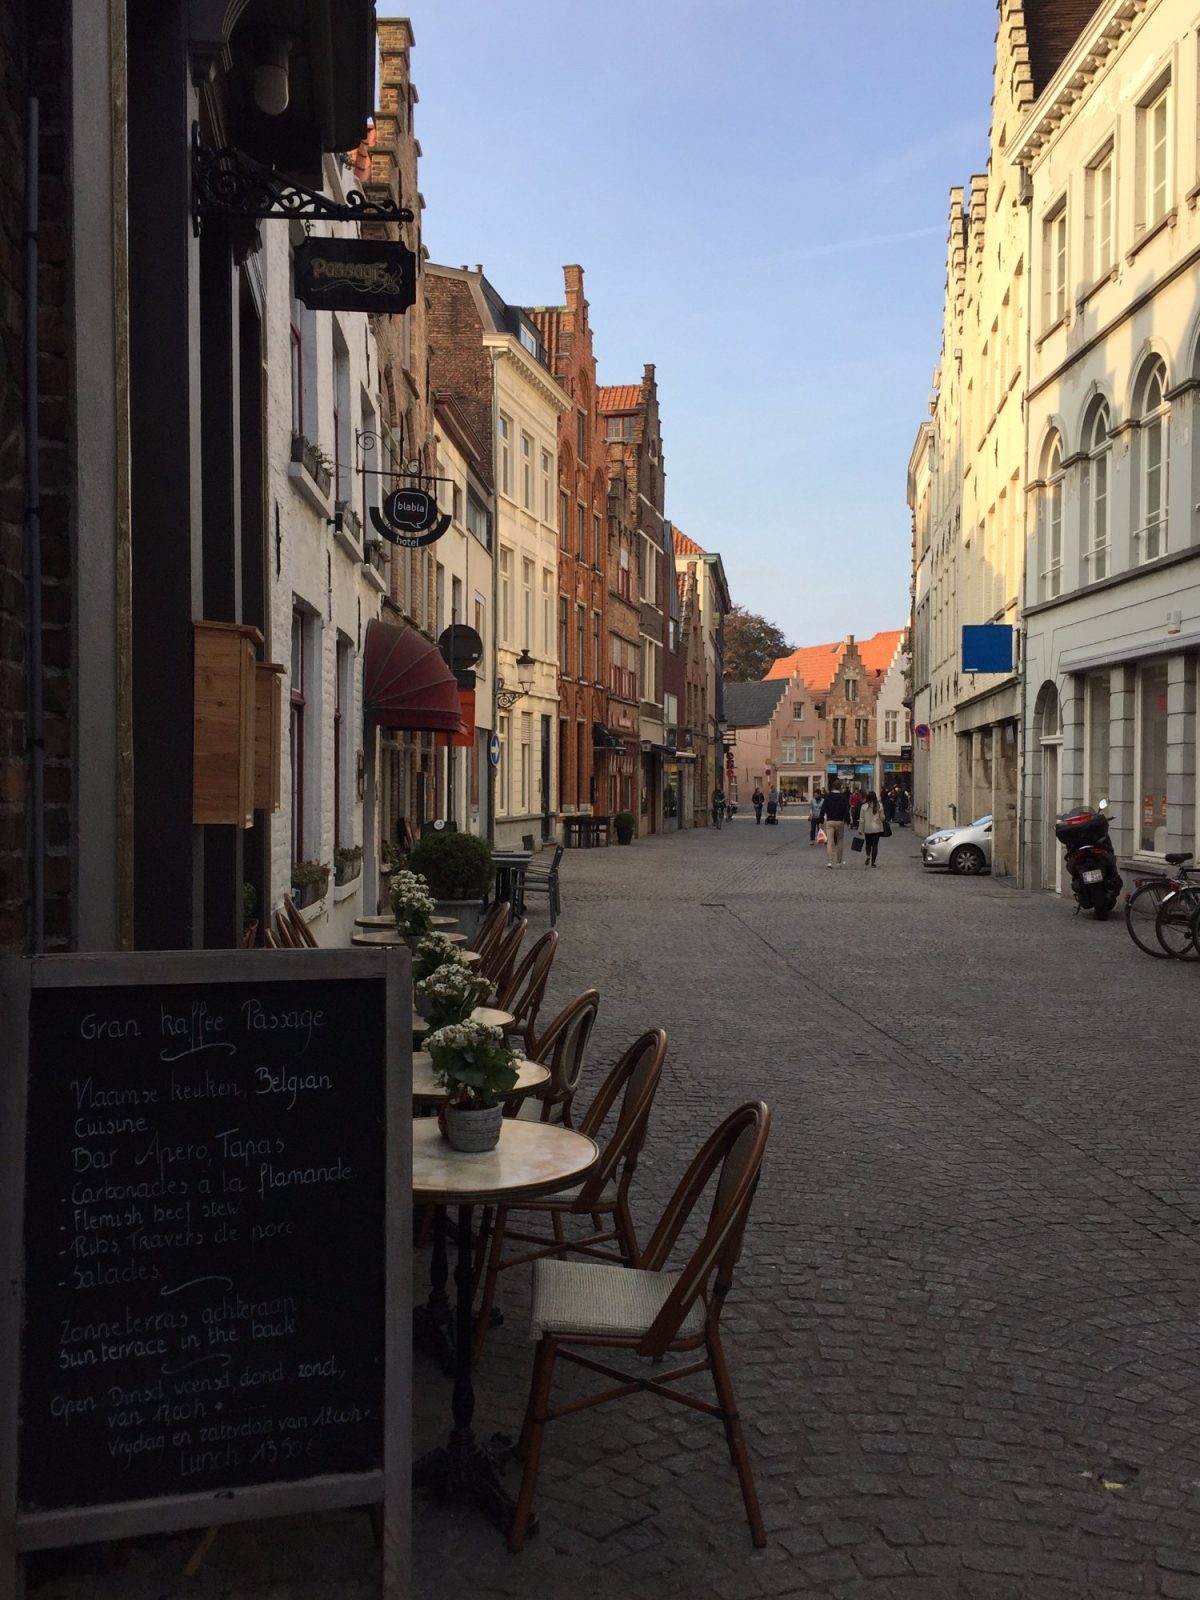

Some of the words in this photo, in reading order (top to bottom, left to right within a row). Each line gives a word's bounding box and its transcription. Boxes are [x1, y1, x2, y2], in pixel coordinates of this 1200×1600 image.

[397, 501, 425, 513] blabla
[396, 535, 419, 547] hotel
[80, 1012, 142, 1040] Gran
[241, 998, 328, 1053] Passage
[255, 1065, 334, 1111] Belgian
[71, 1146, 119, 1172] Bar
[215, 1128, 286, 1168] Tapas
[222, 1167, 248, 1193] la
[258, 1156, 352, 1200] flamande
[74, 1203, 145, 1232] Flemish
[201, 1200, 241, 1218] stew
[214, 1220, 241, 1244] de
[72, 1257, 160, 1290] Salades
[181, 1334, 201, 1351] in
[208, 1326, 240, 1345] the
[252, 1314, 296, 1340] back
[50, 1396, 97, 1426] Open
[107, 1410, 145, 1428] van
[172, 1431, 193, 1446] en
[278, 1415, 308, 1431] van
